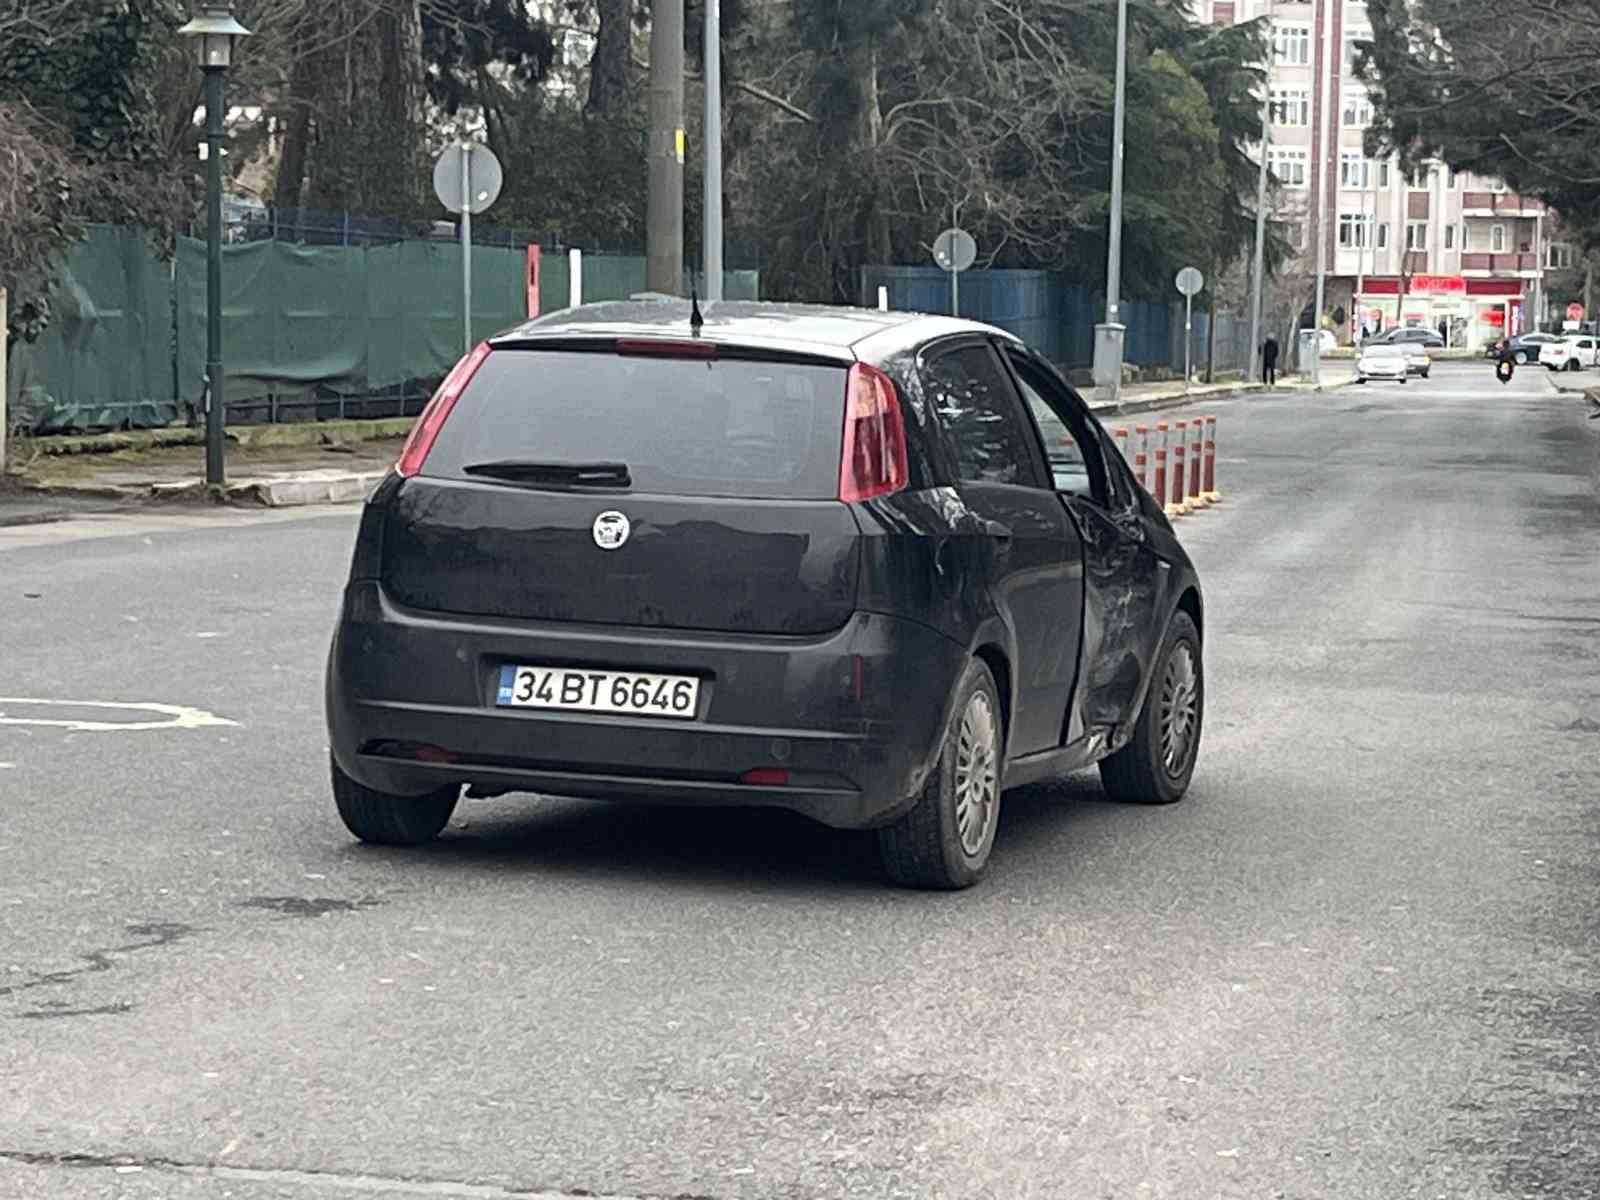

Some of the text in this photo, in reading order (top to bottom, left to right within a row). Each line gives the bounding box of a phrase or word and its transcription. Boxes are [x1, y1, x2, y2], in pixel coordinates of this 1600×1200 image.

[516, 671, 693, 710] 34 BT 6646
